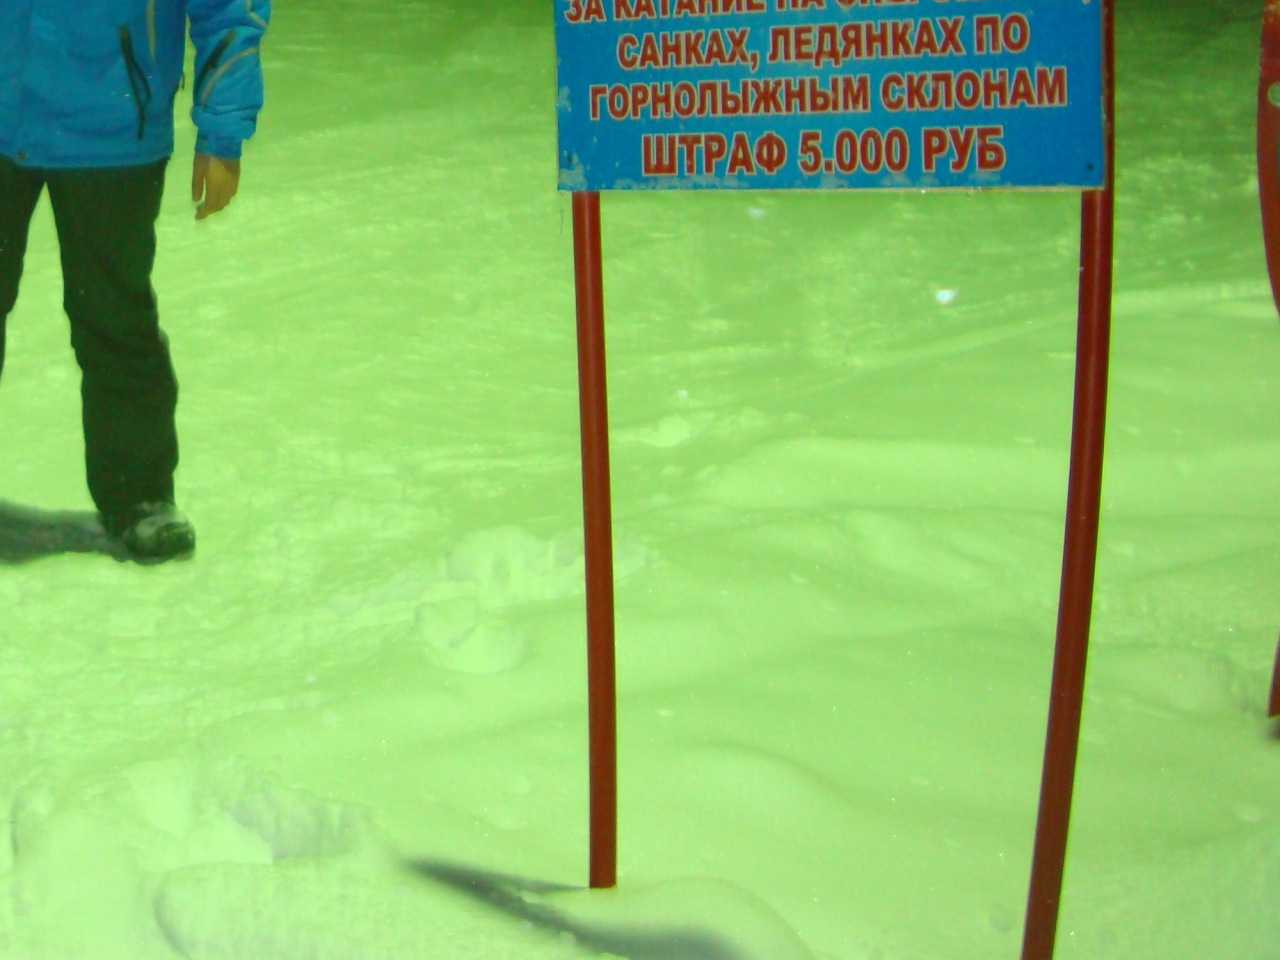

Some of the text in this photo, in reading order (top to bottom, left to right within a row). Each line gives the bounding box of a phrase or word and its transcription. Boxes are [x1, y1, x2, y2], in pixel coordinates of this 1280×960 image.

[617, 12, 1030, 72] САНКАХ, ЛЕДЯНКАХ ПО
[590, 66, 1067, 120] ГОРНОЛЫЖНЫМ СКЛОНАМ
[642, 126, 1006, 176] ШТРАФ 5.000 РУБ
